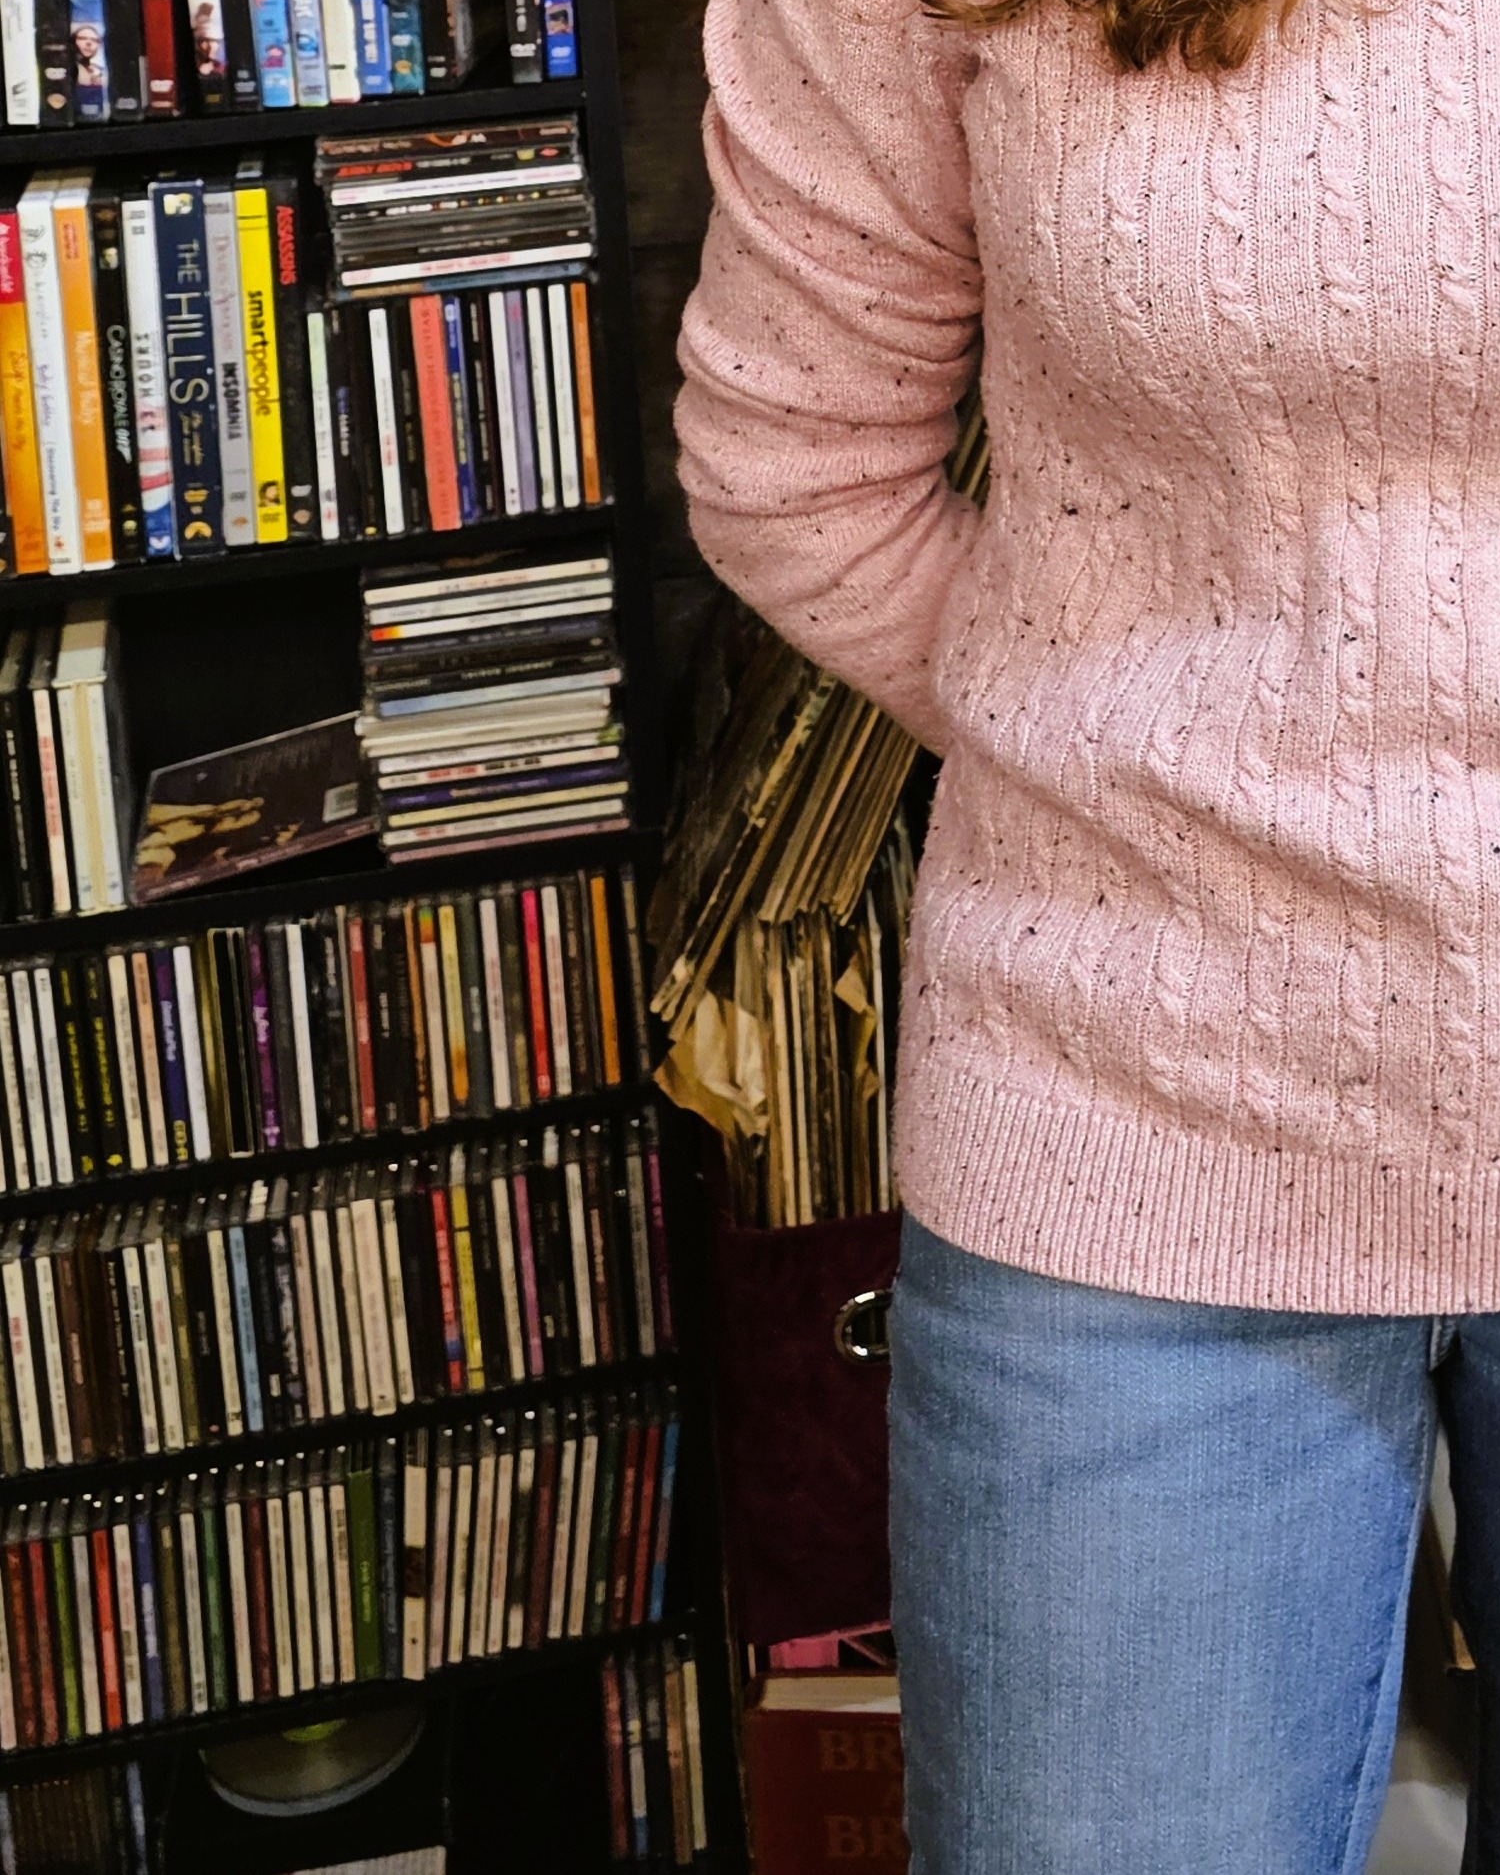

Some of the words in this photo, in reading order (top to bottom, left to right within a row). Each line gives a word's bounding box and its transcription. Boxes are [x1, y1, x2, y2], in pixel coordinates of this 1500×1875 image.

[178, 240, 201, 284] THE
[275, 205, 296, 285] ASSASSINS
[106, 324, 126, 381] CASINO
[134, 331, 153, 399] HOURS
[164, 291, 209, 404] HILLS
[245, 289, 276, 417] smartpeople
[109, 380, 128, 428] ROYALE
[222, 361, 242, 441] INSOMNIA
